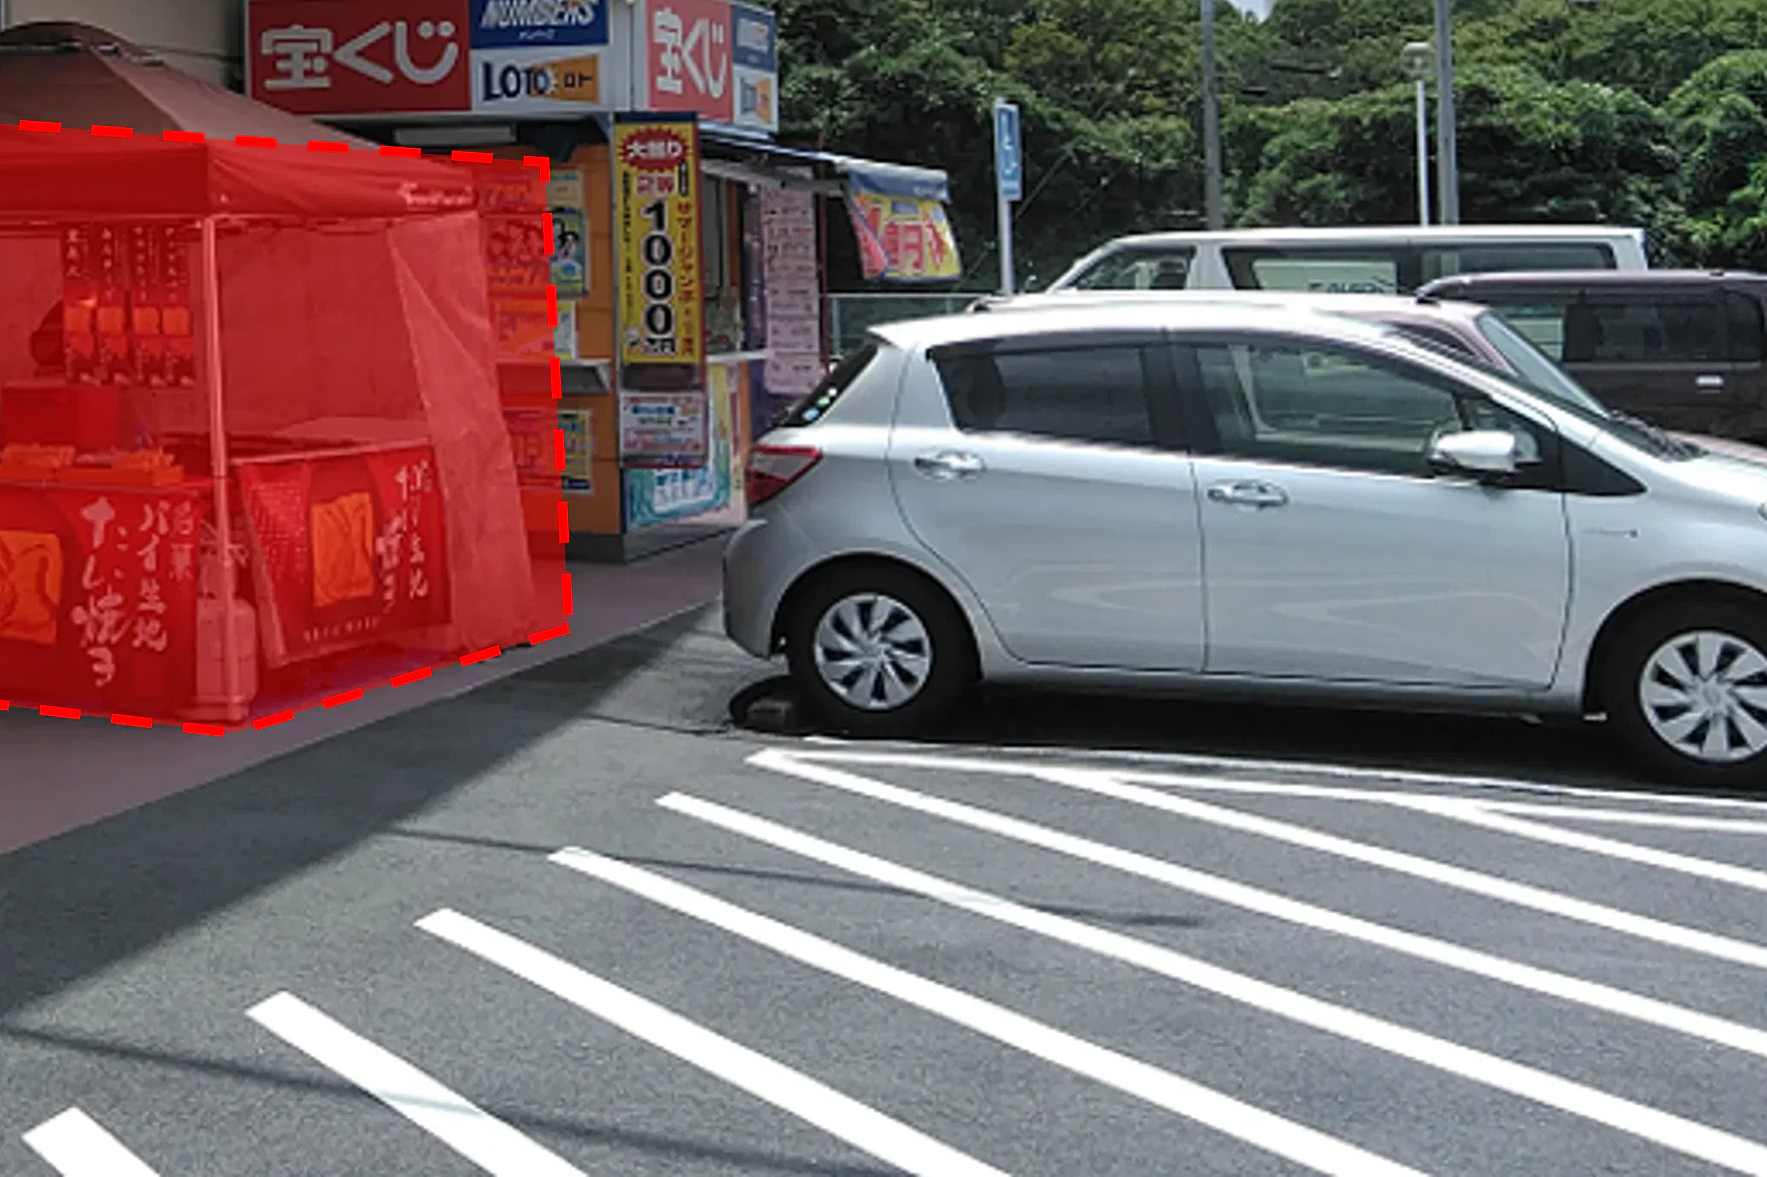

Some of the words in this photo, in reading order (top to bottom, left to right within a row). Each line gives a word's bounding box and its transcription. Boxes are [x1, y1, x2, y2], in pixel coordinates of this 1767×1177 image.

[260, 22, 460, 87] 宝くじ
[653, 7, 727, 100] 宝くじ
